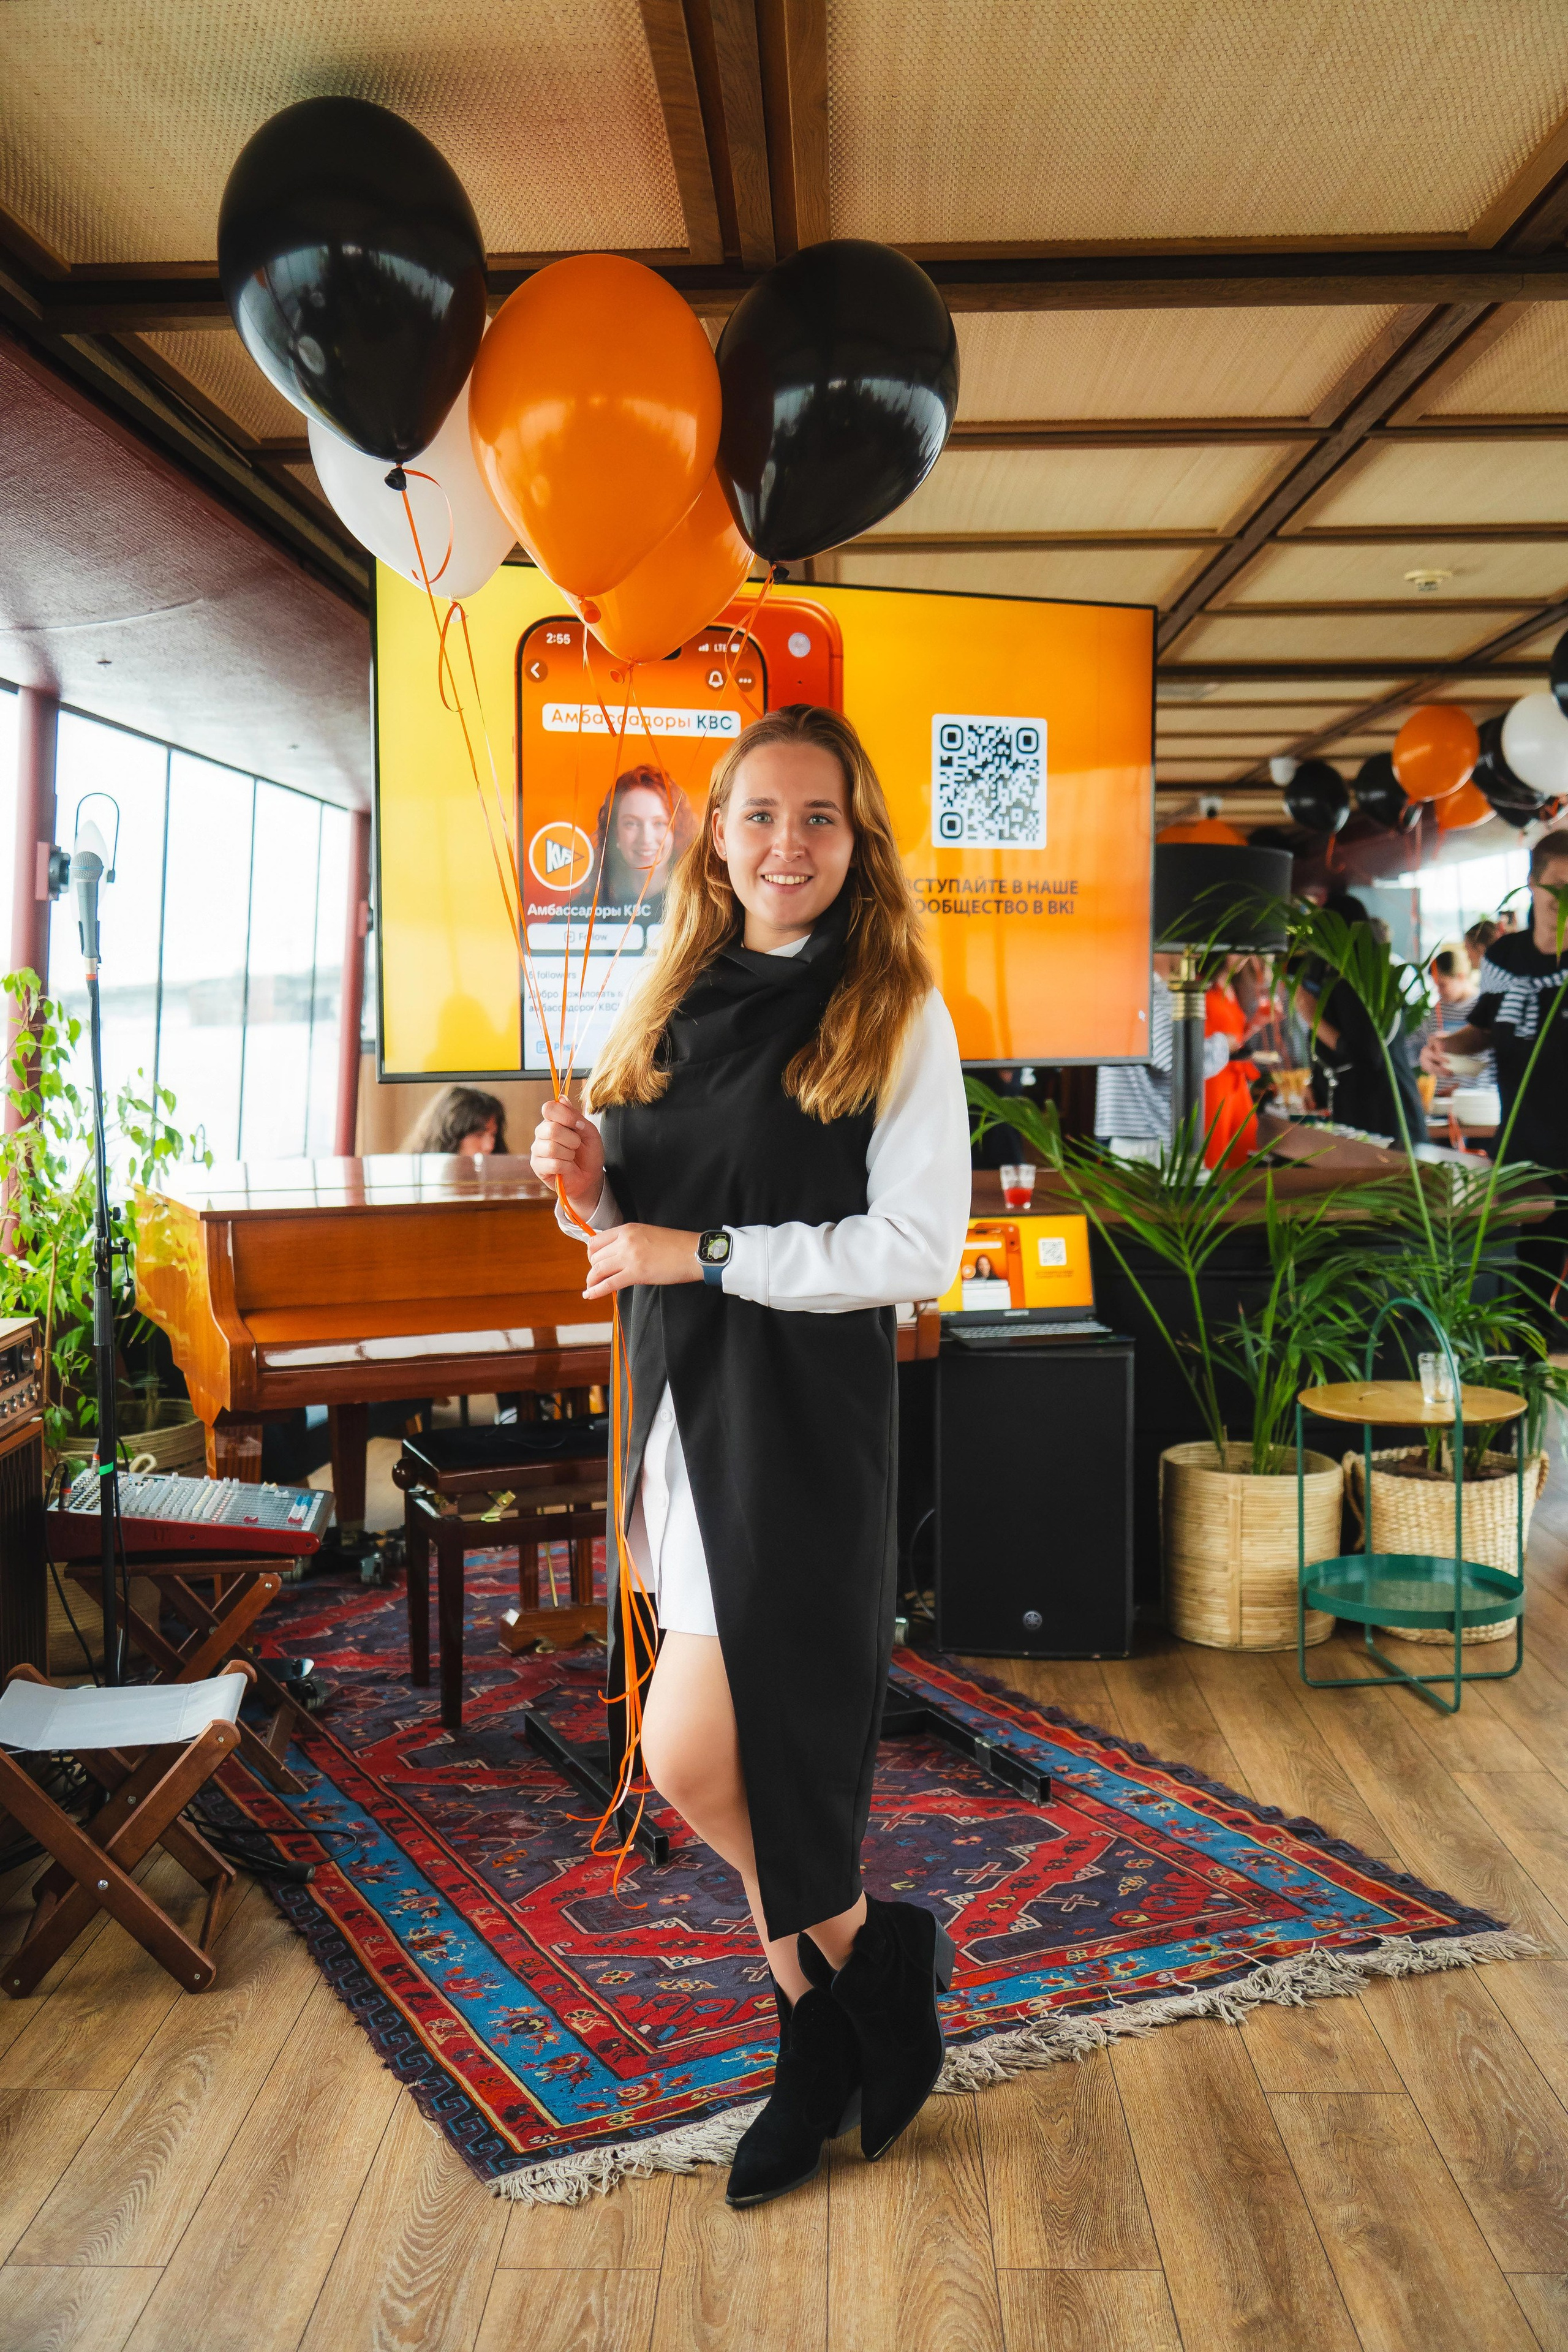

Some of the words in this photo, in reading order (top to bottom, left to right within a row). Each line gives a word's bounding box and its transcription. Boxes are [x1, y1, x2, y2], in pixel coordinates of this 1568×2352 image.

[697, 715, 732, 730] КВС
[905, 876, 1008, 894] СТУПАЙТЕ
[1012, 880, 1022, 894] В
[1027, 880, 1079, 895] НАШЕ
[527, 903, 621, 919] Амбассадоры
[624, 904, 651, 916] КВС
[913, 899, 1028, 918] ООБЩЕСТВО
[1033, 900, 1043, 914] В
[1048, 900, 1074, 915] ВК!
[537, 971, 577, 979] followrs
[529, 990, 559, 1000] Дбро
